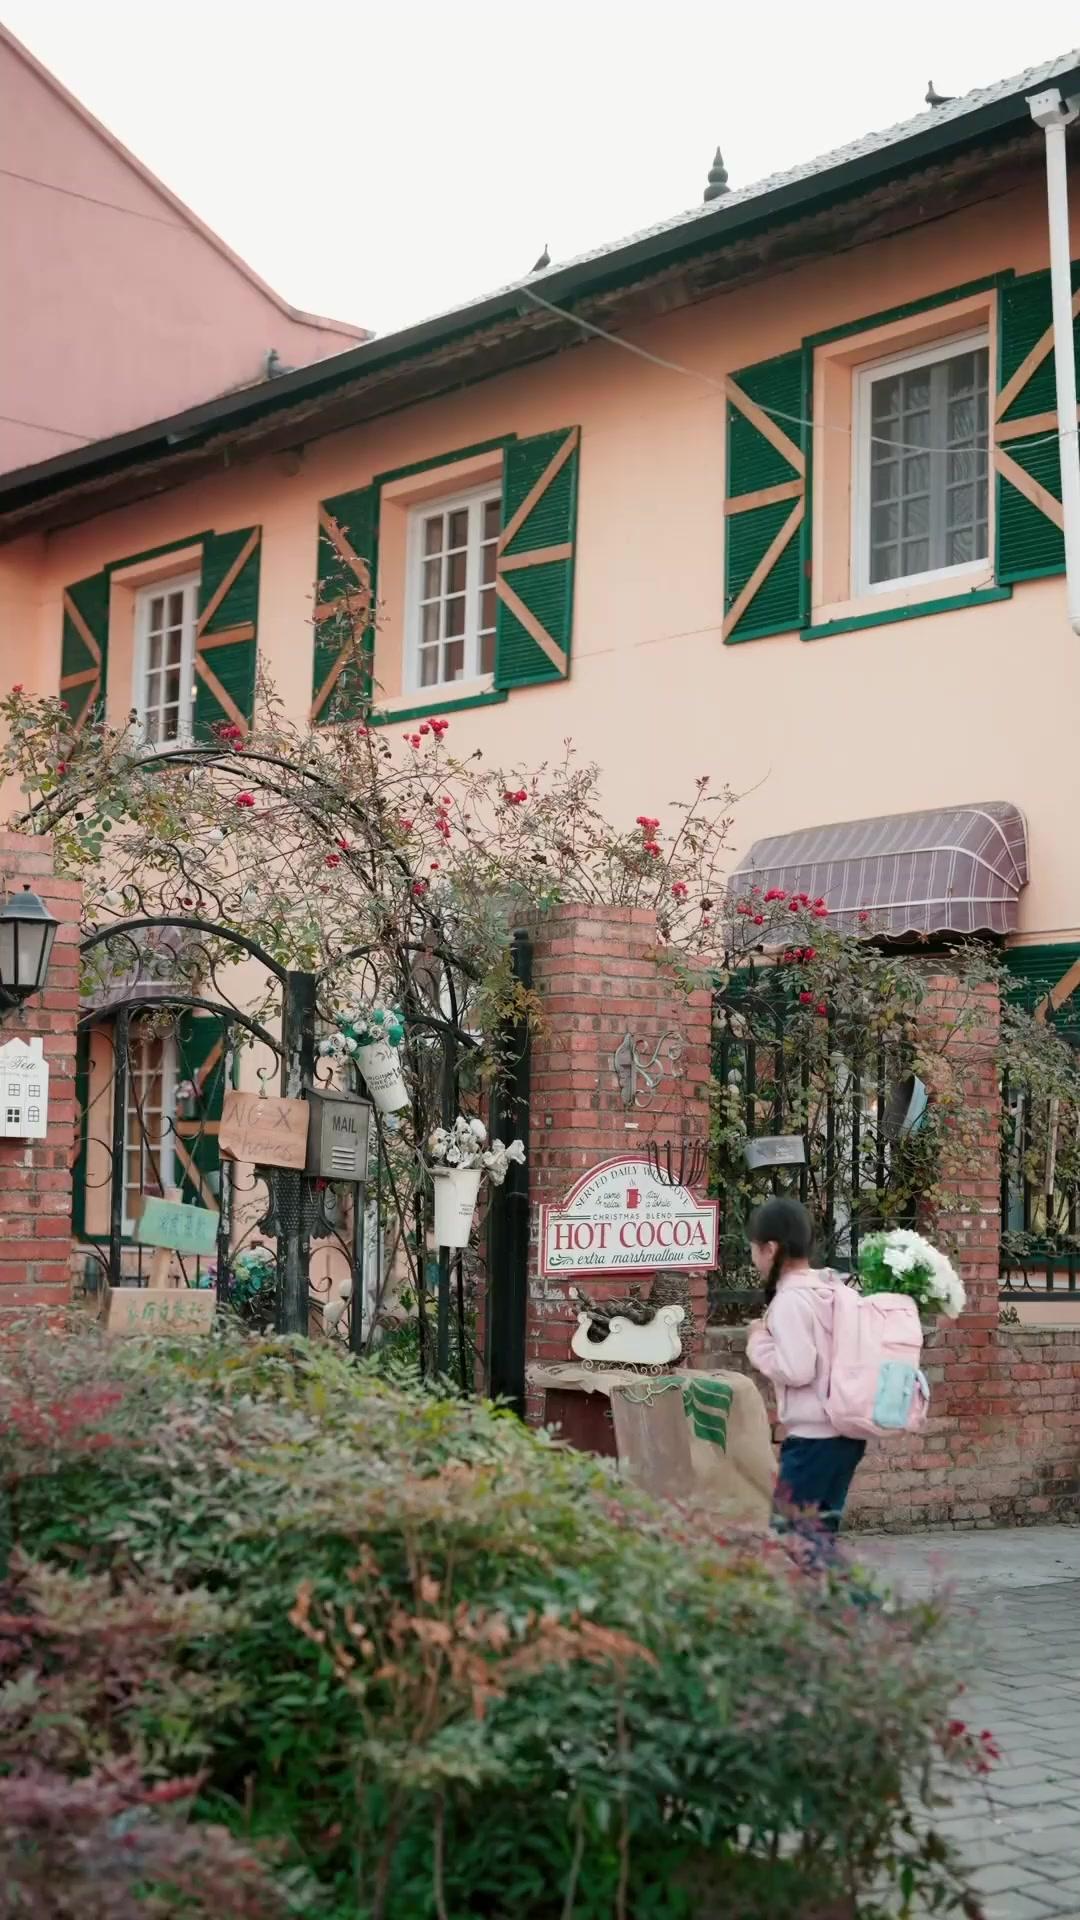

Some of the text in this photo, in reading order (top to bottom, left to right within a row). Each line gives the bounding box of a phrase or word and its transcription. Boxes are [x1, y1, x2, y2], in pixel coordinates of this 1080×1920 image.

[8, 1056, 37, 1070] Tea
[332, 1115, 357, 1134] MAIL
[575, 1175, 608, 1207] SERVED
[611, 1166, 637, 1179] DAILY
[643, 1166, 669, 1182] WIH
[592, 1213, 640, 1221] CHRISTMAS
[554, 1220, 708, 1250] HOT COCOA
[577, 1249, 684, 1265] extra marshmallow
